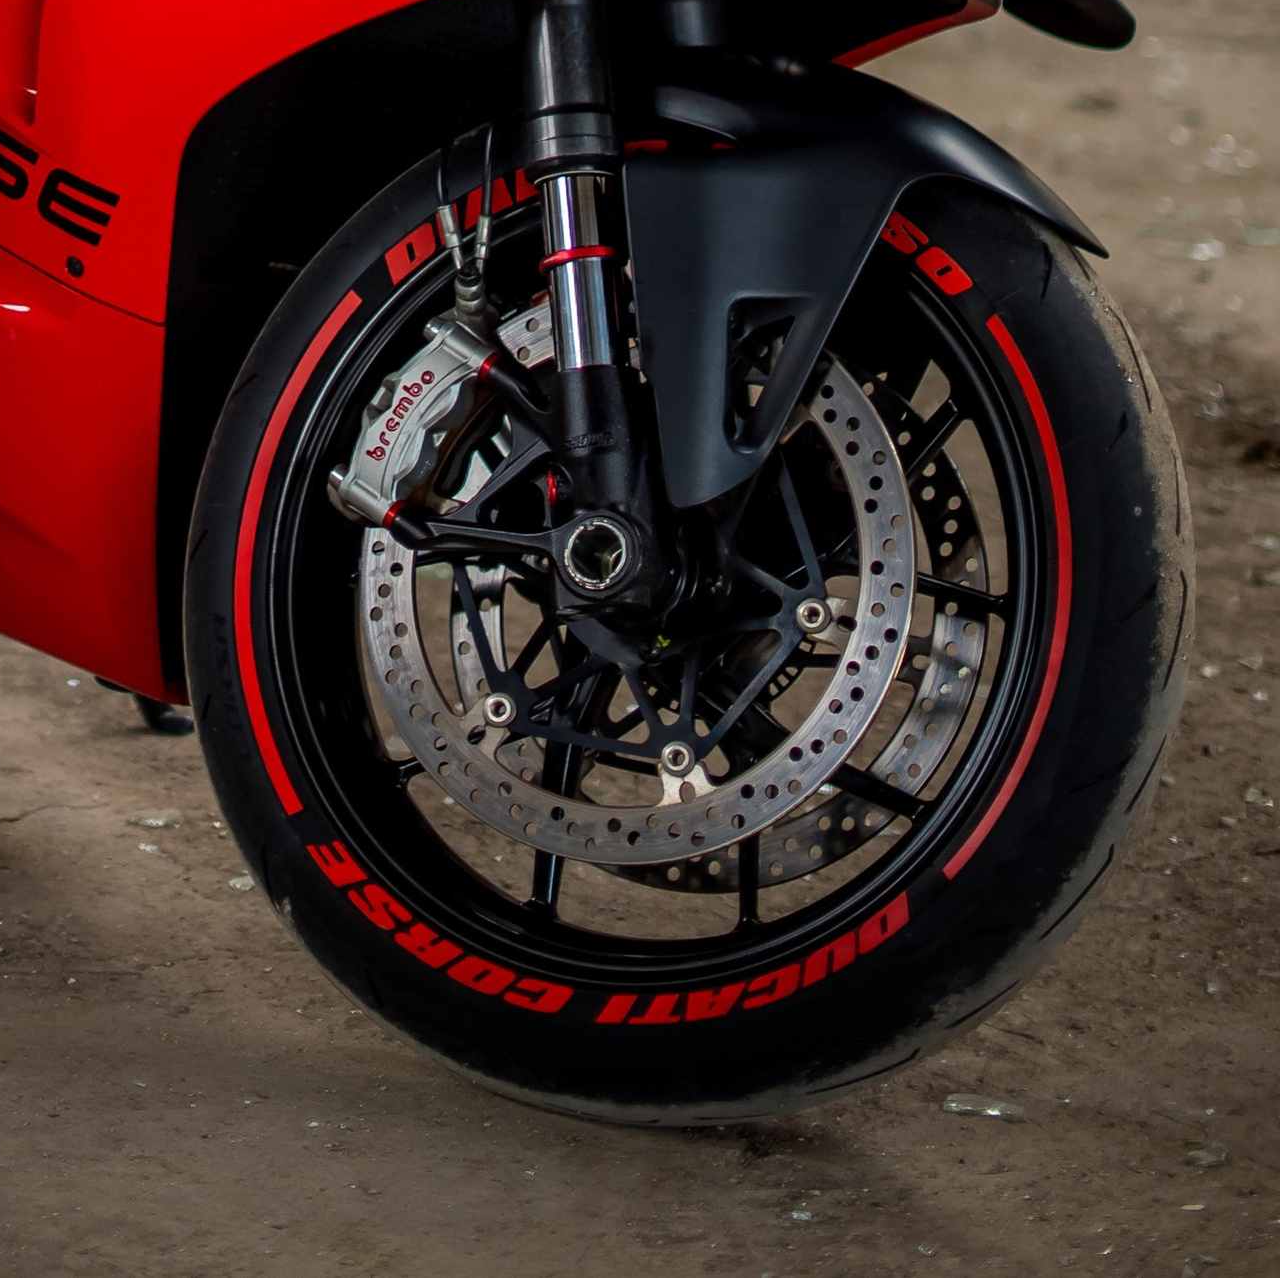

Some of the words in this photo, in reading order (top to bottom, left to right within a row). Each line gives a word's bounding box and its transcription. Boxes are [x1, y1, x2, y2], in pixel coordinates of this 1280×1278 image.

[365, 369, 437, 462] brembo
[305, 839, 576, 1015] CORSE
[593, 890, 911, 1025] DUCATI
